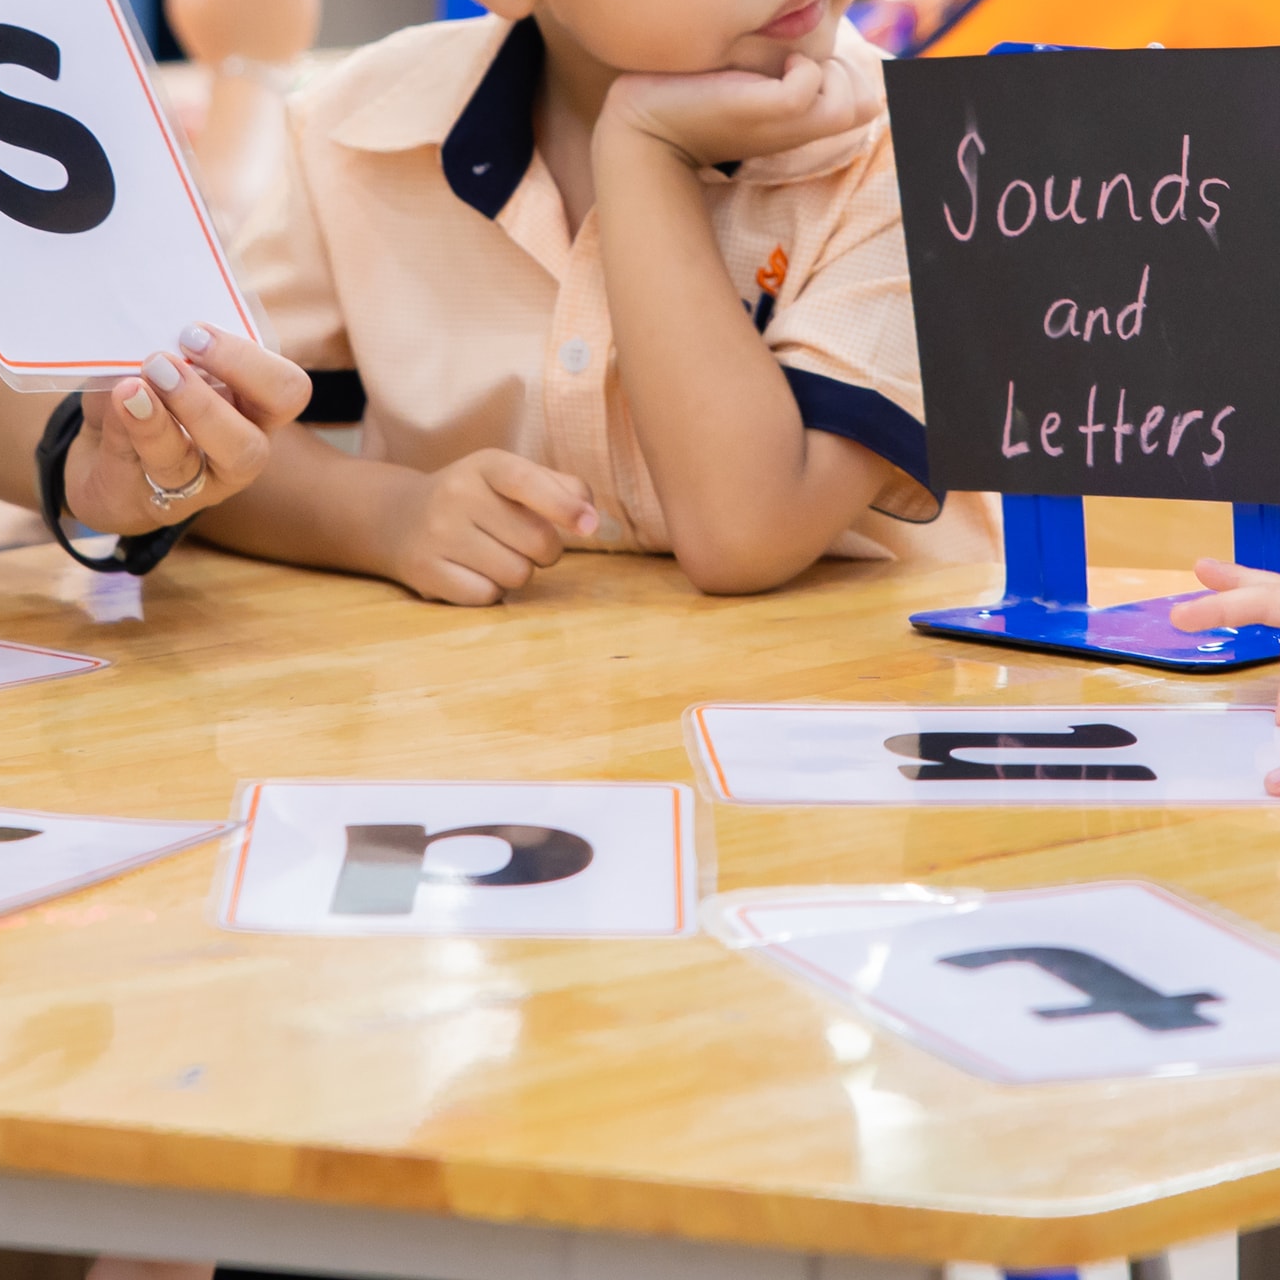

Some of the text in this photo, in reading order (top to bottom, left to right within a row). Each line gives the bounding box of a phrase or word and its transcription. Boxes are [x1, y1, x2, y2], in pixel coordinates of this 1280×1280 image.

[943, 130, 1230, 242] Sounds
[1043, 264, 1150, 342] and
[1001, 380, 1236, 468] Letters
